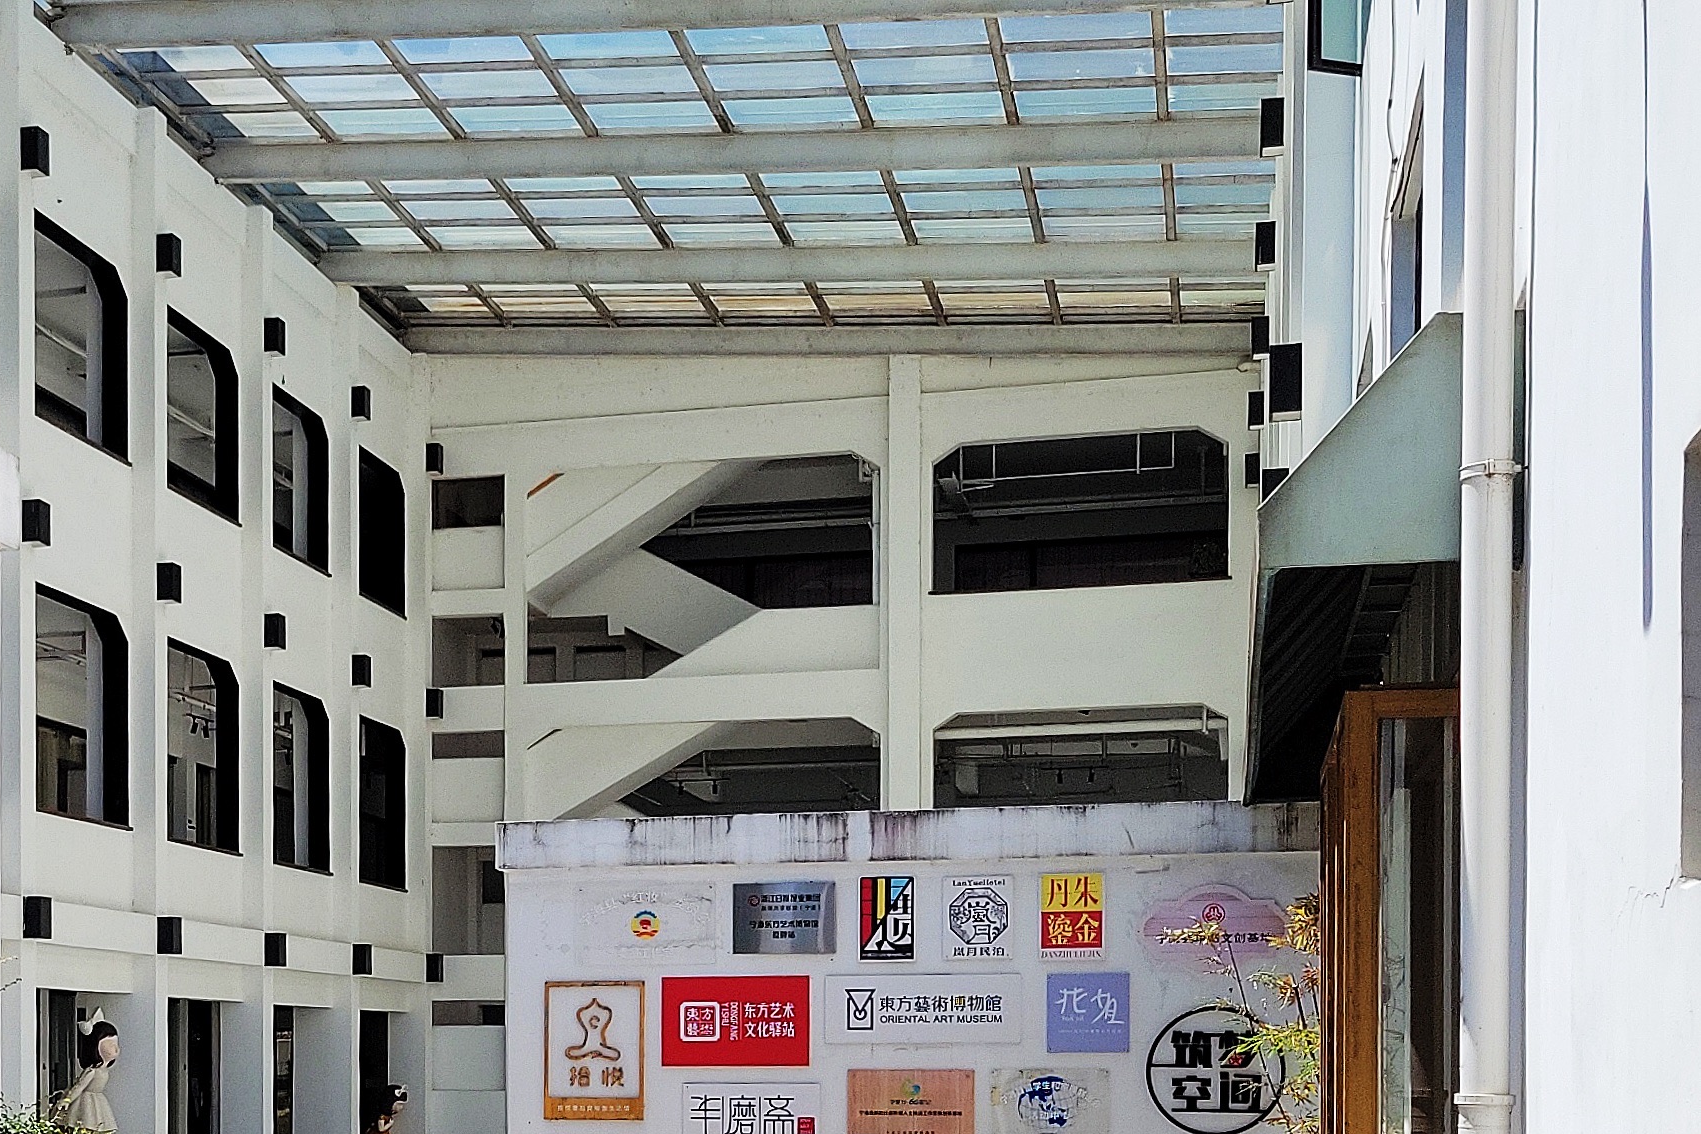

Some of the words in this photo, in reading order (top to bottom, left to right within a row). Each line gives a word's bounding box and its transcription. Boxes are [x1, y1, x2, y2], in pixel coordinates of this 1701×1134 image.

[744, 1002, 795, 1019] 东方艺术
[878, 994, 1003, 1013] 東方藝術博物館
[879, 1014, 930, 1024] ORIENTAL
[933, 1014, 954, 1023] ART
[956, 1014, 1003, 1023] MUSEUM
[744, 1021, 795, 1038] 文化驿站
[1171, 1071, 1262, 1113] 空间
